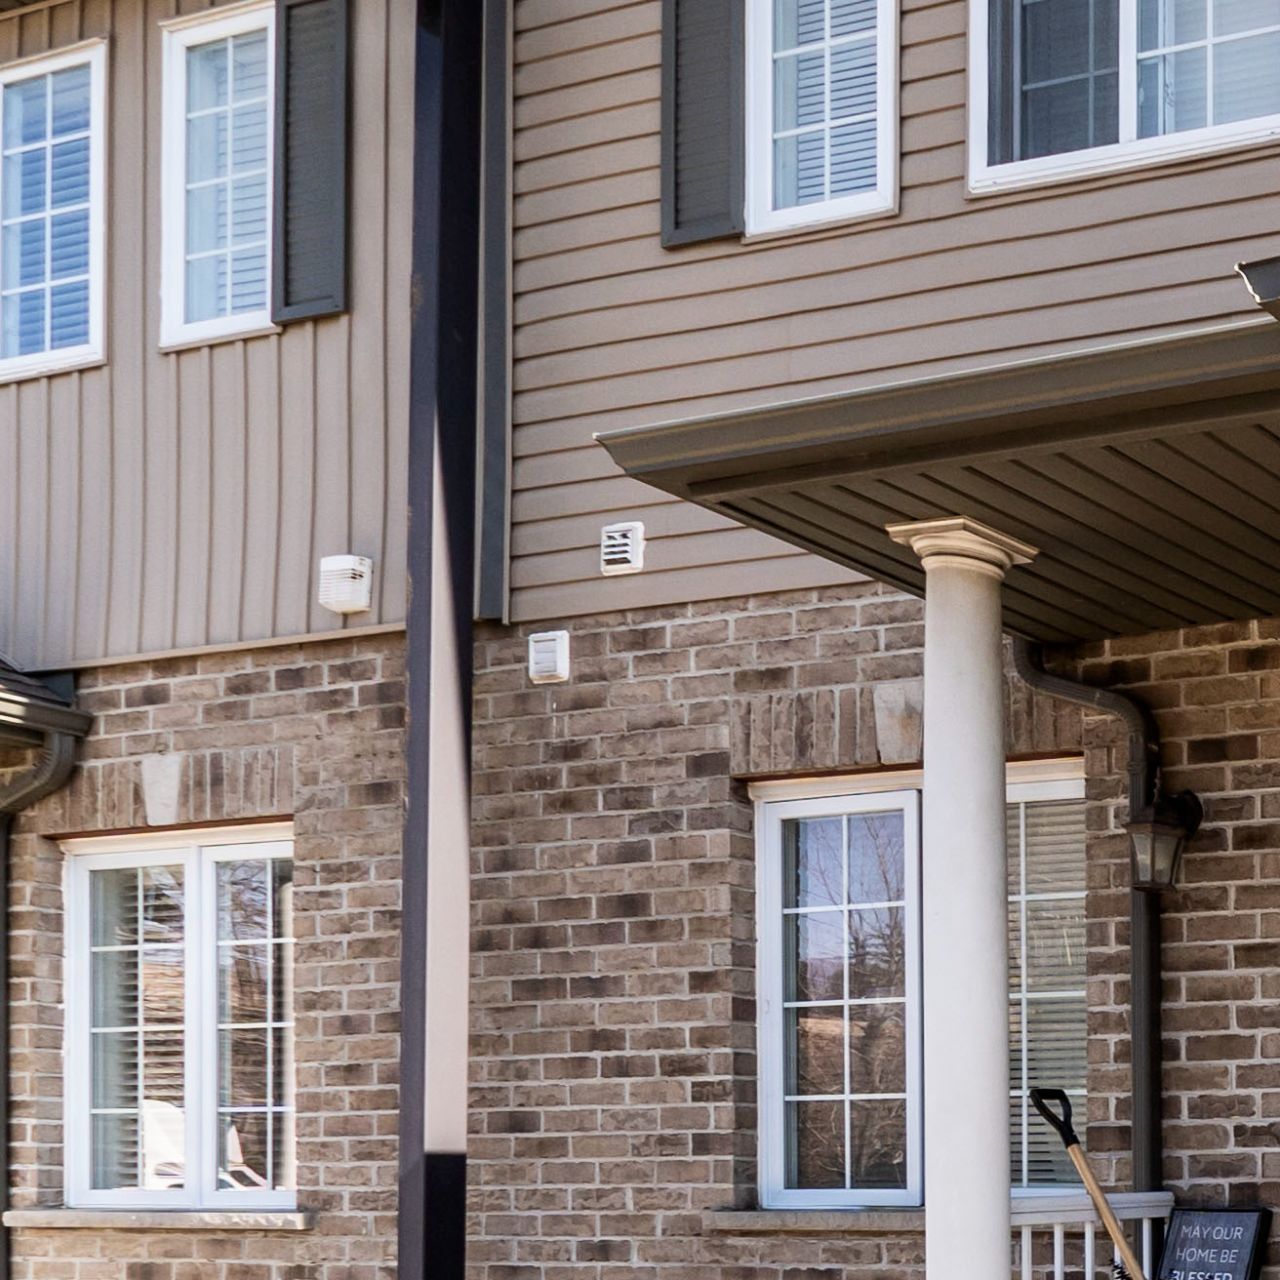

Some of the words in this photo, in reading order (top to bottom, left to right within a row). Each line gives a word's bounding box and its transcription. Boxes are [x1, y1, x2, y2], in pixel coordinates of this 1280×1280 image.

[1180, 1225, 1211, 1240] MAY
[1213, 1226, 1244, 1240] OUR
[1176, 1248, 1218, 1262] HOME
[1220, 1249, 1239, 1263] BE
